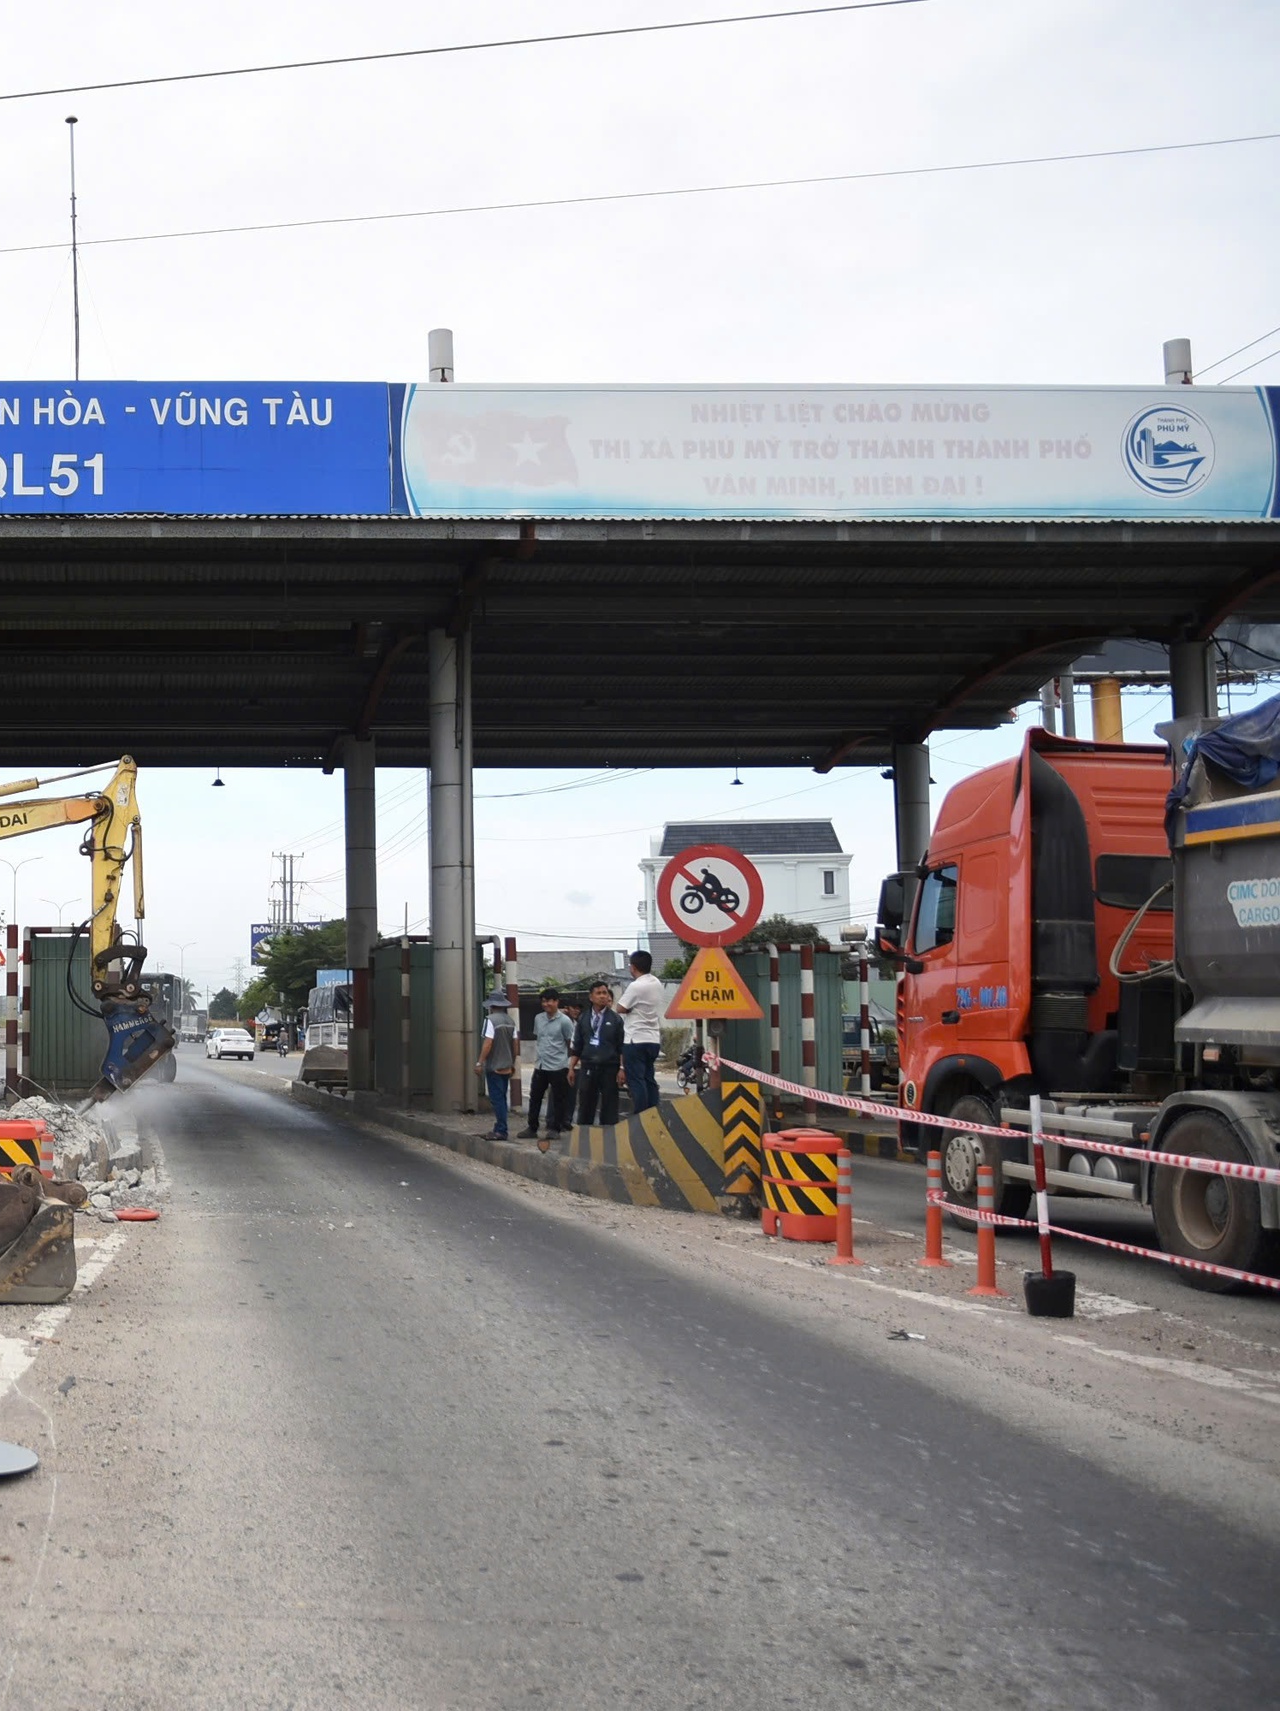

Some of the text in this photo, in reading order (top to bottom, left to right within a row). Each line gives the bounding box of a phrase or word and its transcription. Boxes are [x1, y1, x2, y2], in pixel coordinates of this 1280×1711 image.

[33, 390, 106, 426] HÒA
[150, 391, 248, 426] VŨNG
[262, 390, 333, 426] TÀU
[1229, 883, 1258, 900] CIMC
[705, 971, 720, 982] ĐI
[691, 986, 735, 1004] CHẬM
